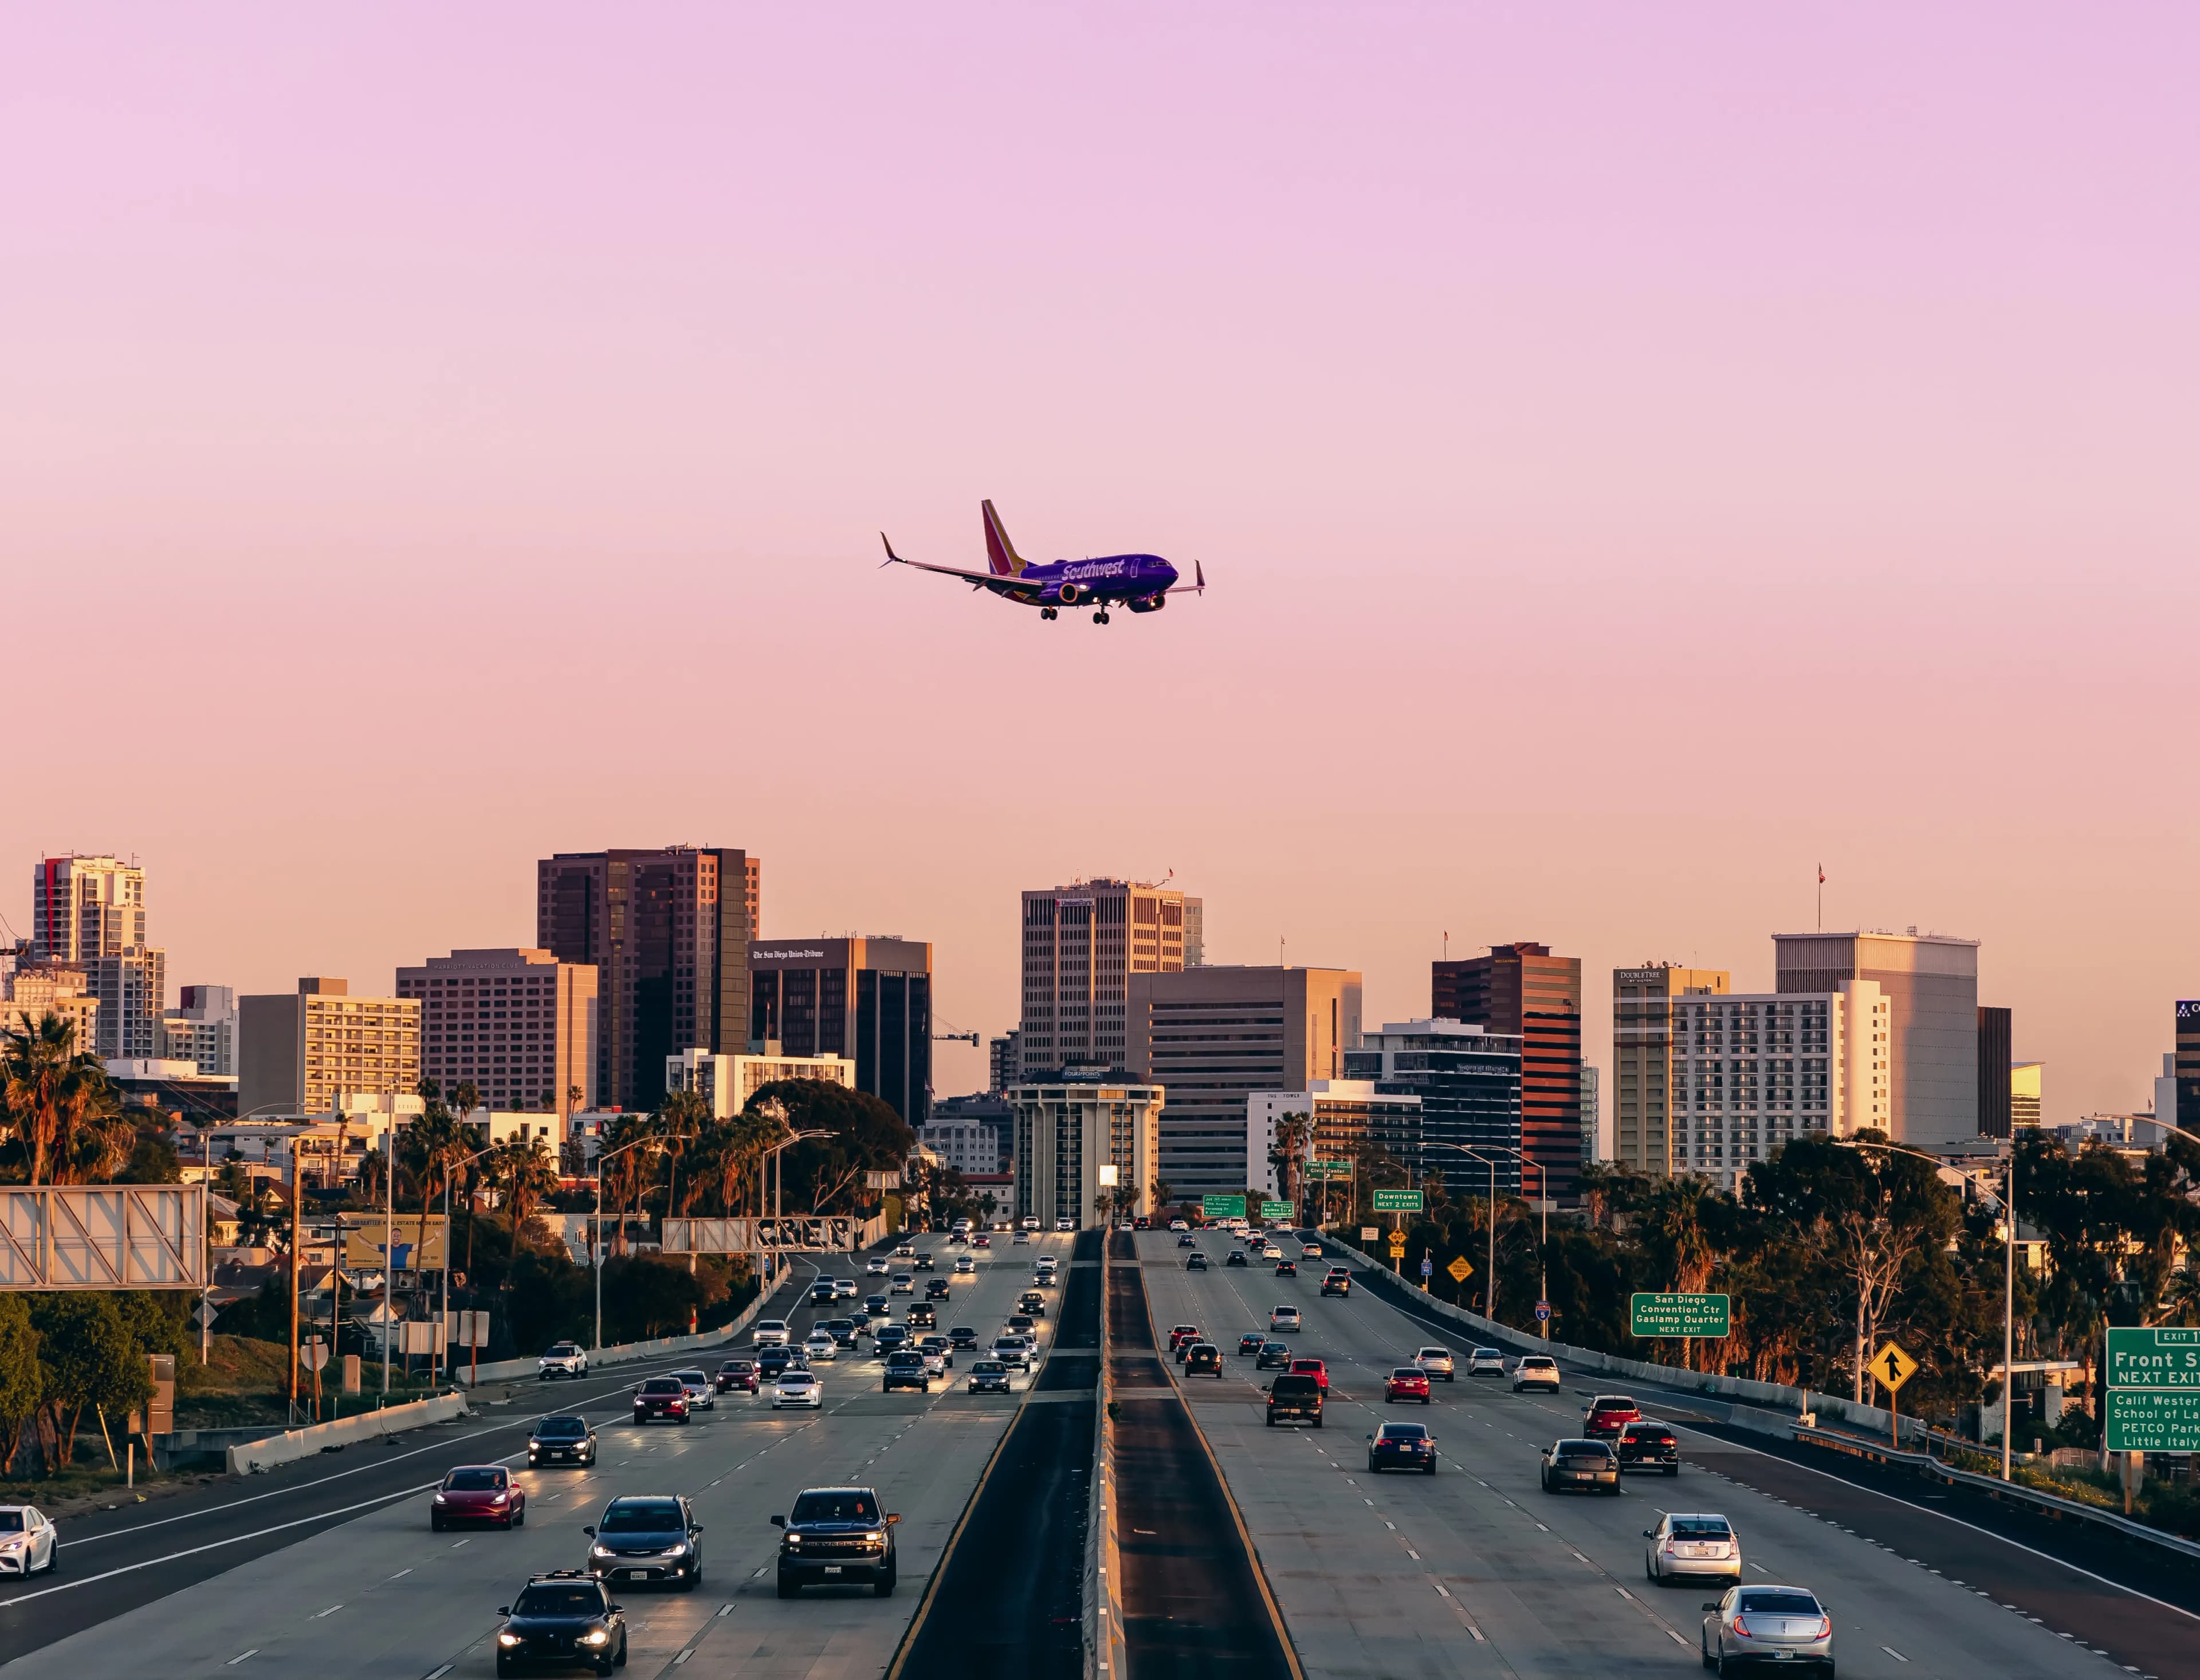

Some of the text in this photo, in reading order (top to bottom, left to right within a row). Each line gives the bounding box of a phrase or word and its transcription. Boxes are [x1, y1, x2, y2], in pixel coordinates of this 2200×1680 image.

[1062, 559, 1125, 581] Southwest
[774, 951, 788, 959] Diego
[788, 950, 824, 958] Union-Tribune
[1678, 1296, 1706, 1305] Diego
[1641, 1305, 1698, 1313] Convention
[1636, 1315, 1724, 1324] Gaslamp Quarter
[2193, 1331, 2200, 1343] 1
[2115, 1352, 2200, 1367] Front S
[2119, 1371, 2162, 1383] NEXT
[2116, 1395, 2198, 1406] Calif Wester
[2114, 1409, 2199, 1419] School of La
[2122, 1423, 2200, 1433] PETCO Park
[2124, 1437, 2198, 1449] Little Italy
